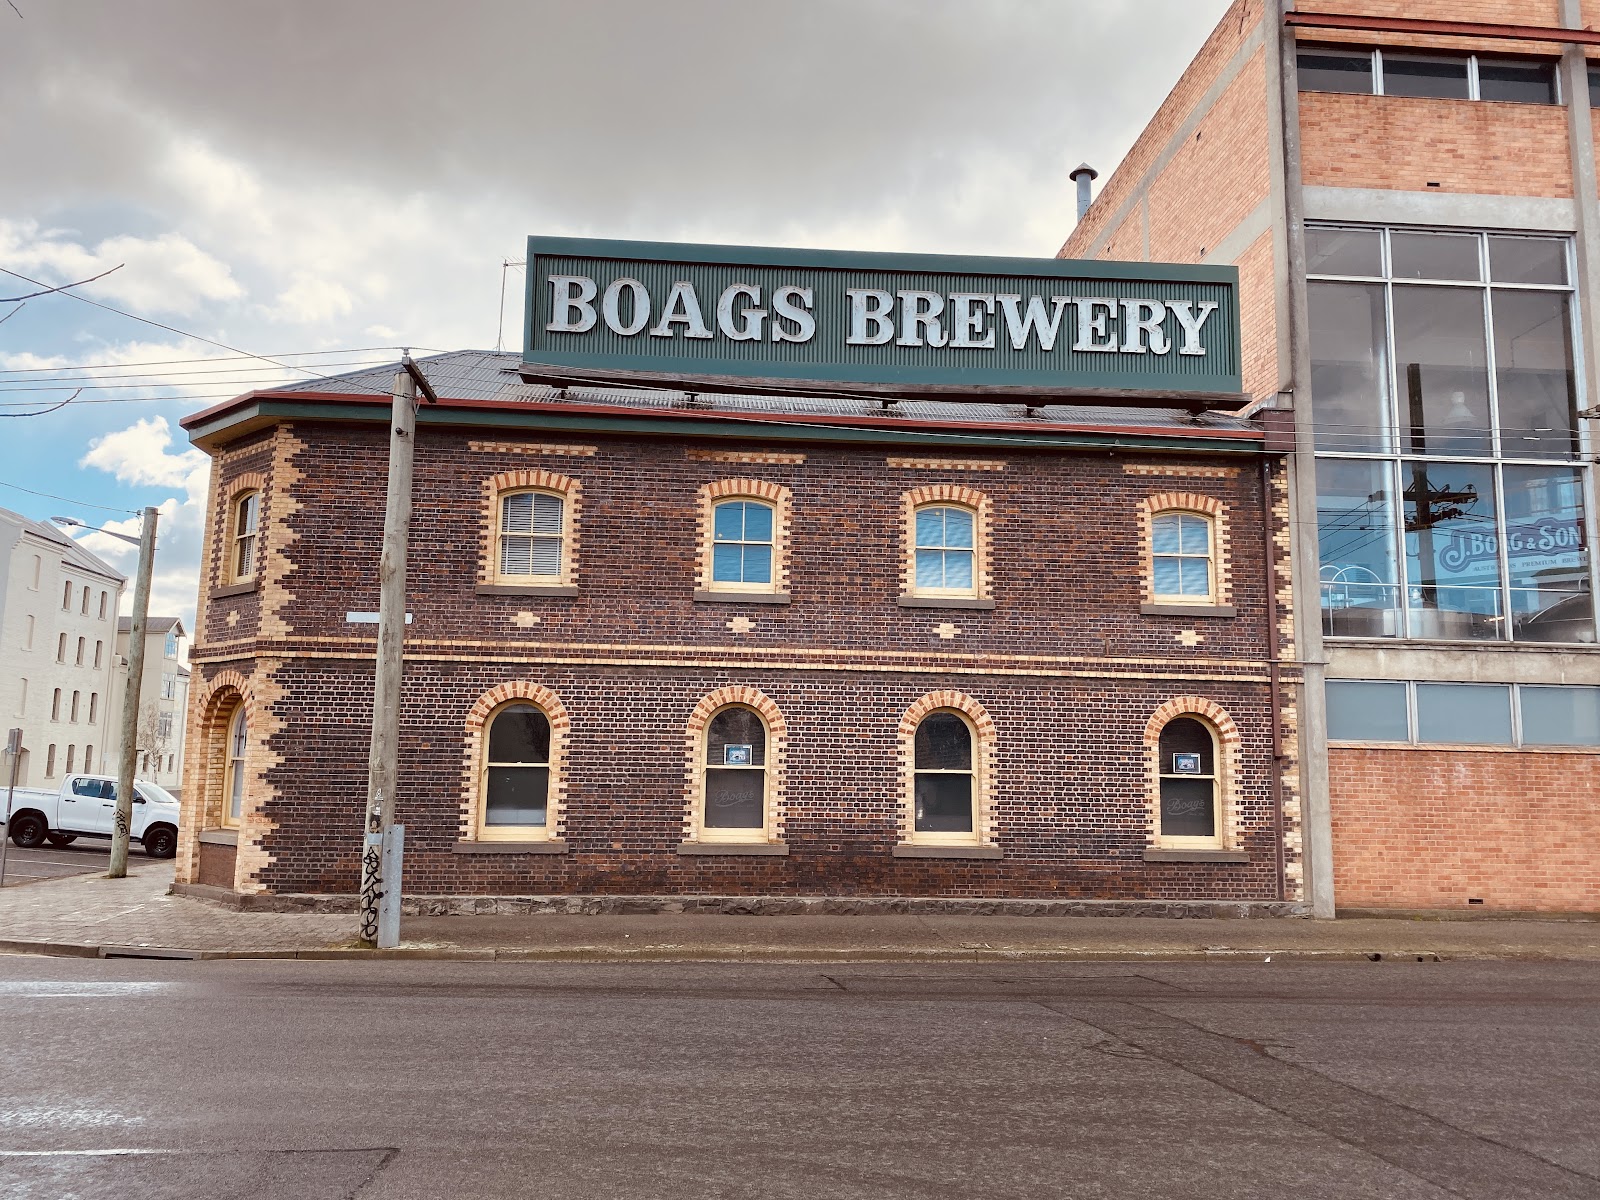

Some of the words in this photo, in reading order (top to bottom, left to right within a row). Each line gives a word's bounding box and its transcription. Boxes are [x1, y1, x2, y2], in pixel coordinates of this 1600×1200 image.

[546, 274, 817, 344] BOAGS
[845, 287, 1220, 356] BREWERY
[1527, 537, 1537, 550] &
[1521, 559, 1557, 568] PREMIUM
